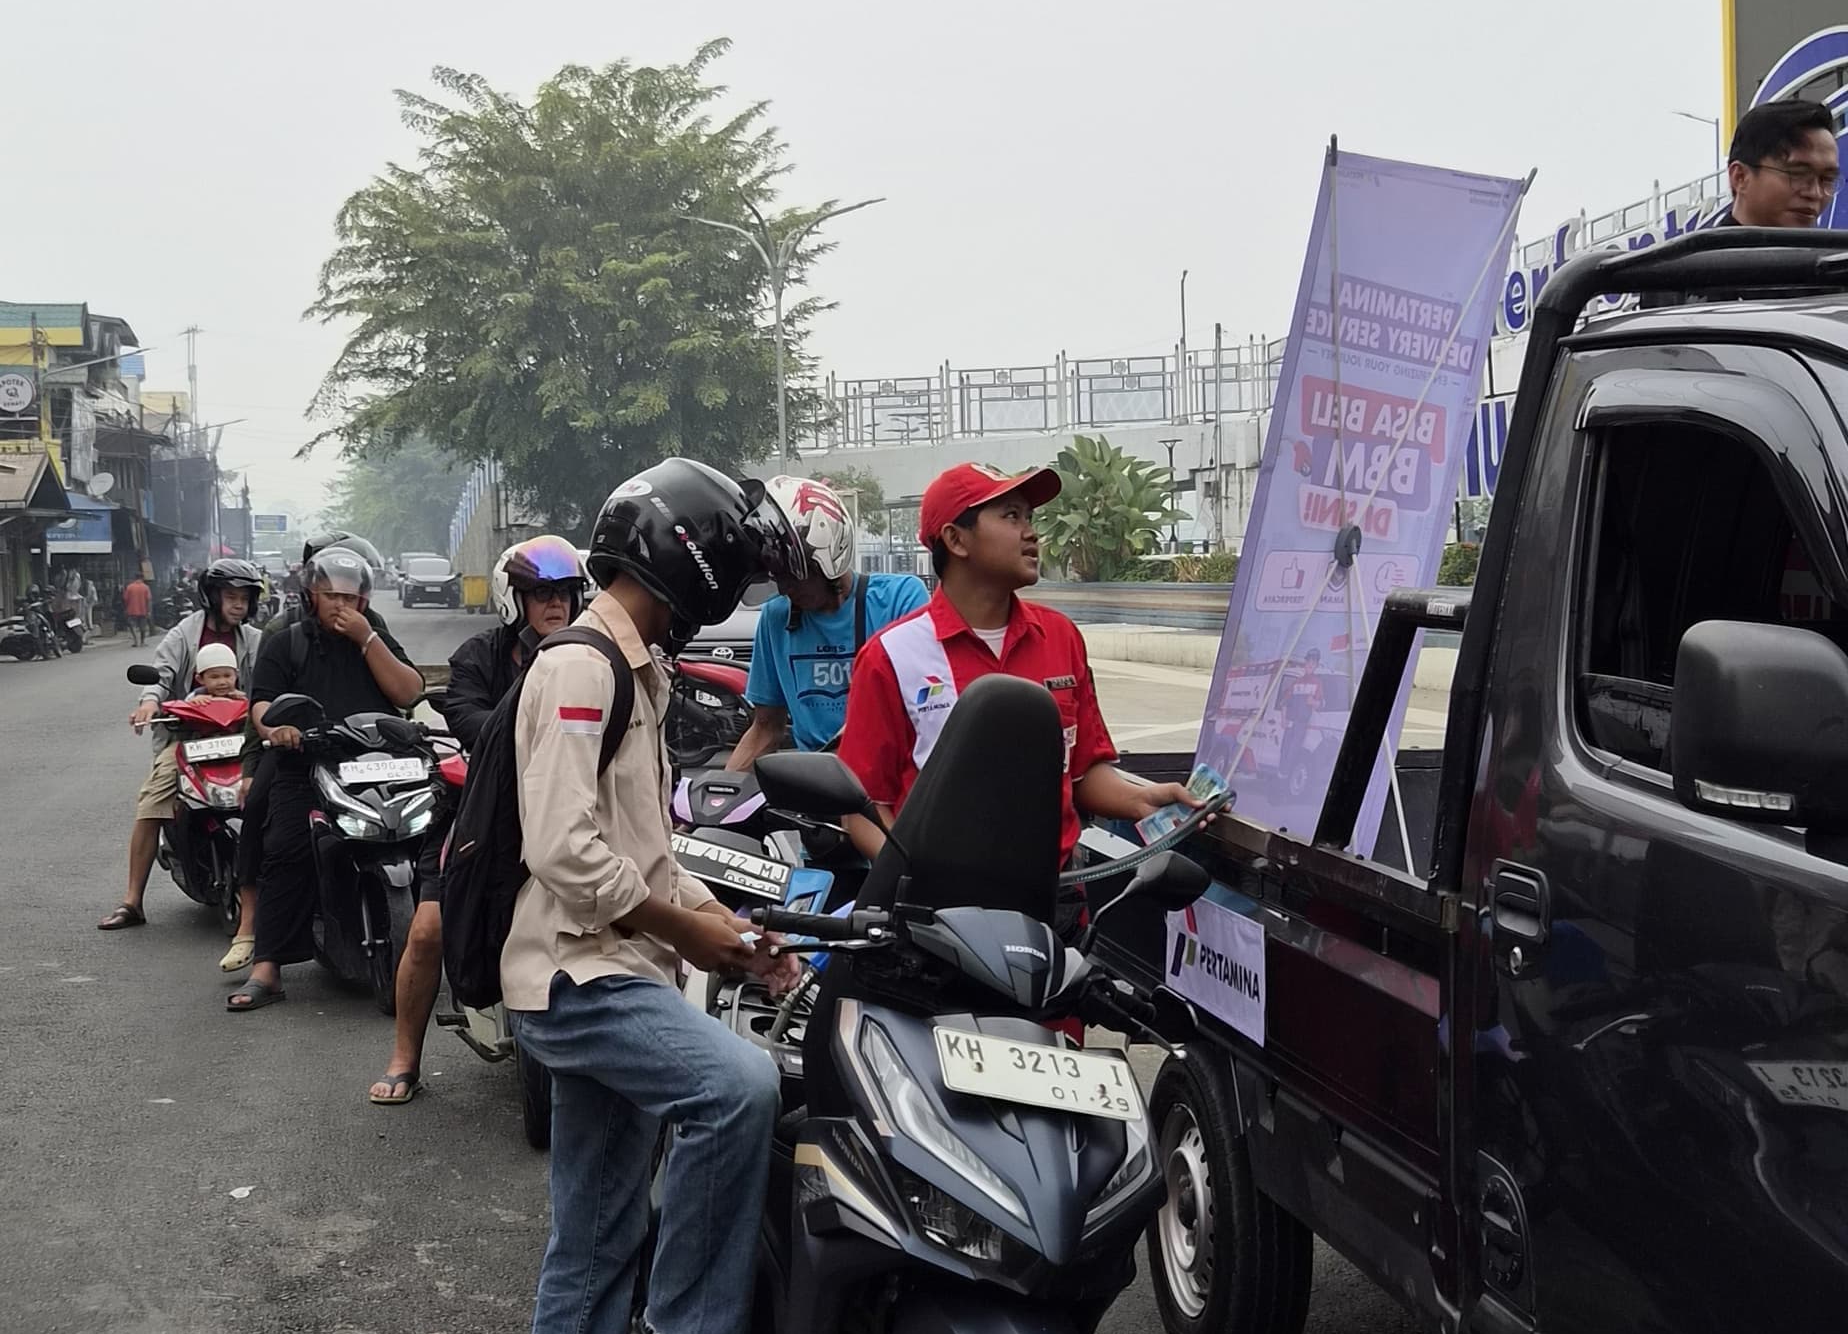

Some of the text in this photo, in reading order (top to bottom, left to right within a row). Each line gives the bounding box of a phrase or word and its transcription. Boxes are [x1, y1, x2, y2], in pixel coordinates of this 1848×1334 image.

[1004, 944, 1048, 962] HONDA
[1200, 943, 1260, 1003] PERTAMINA
[944, 1033, 985, 1062] KH
[1008, 1047, 1082, 1079] 3213
